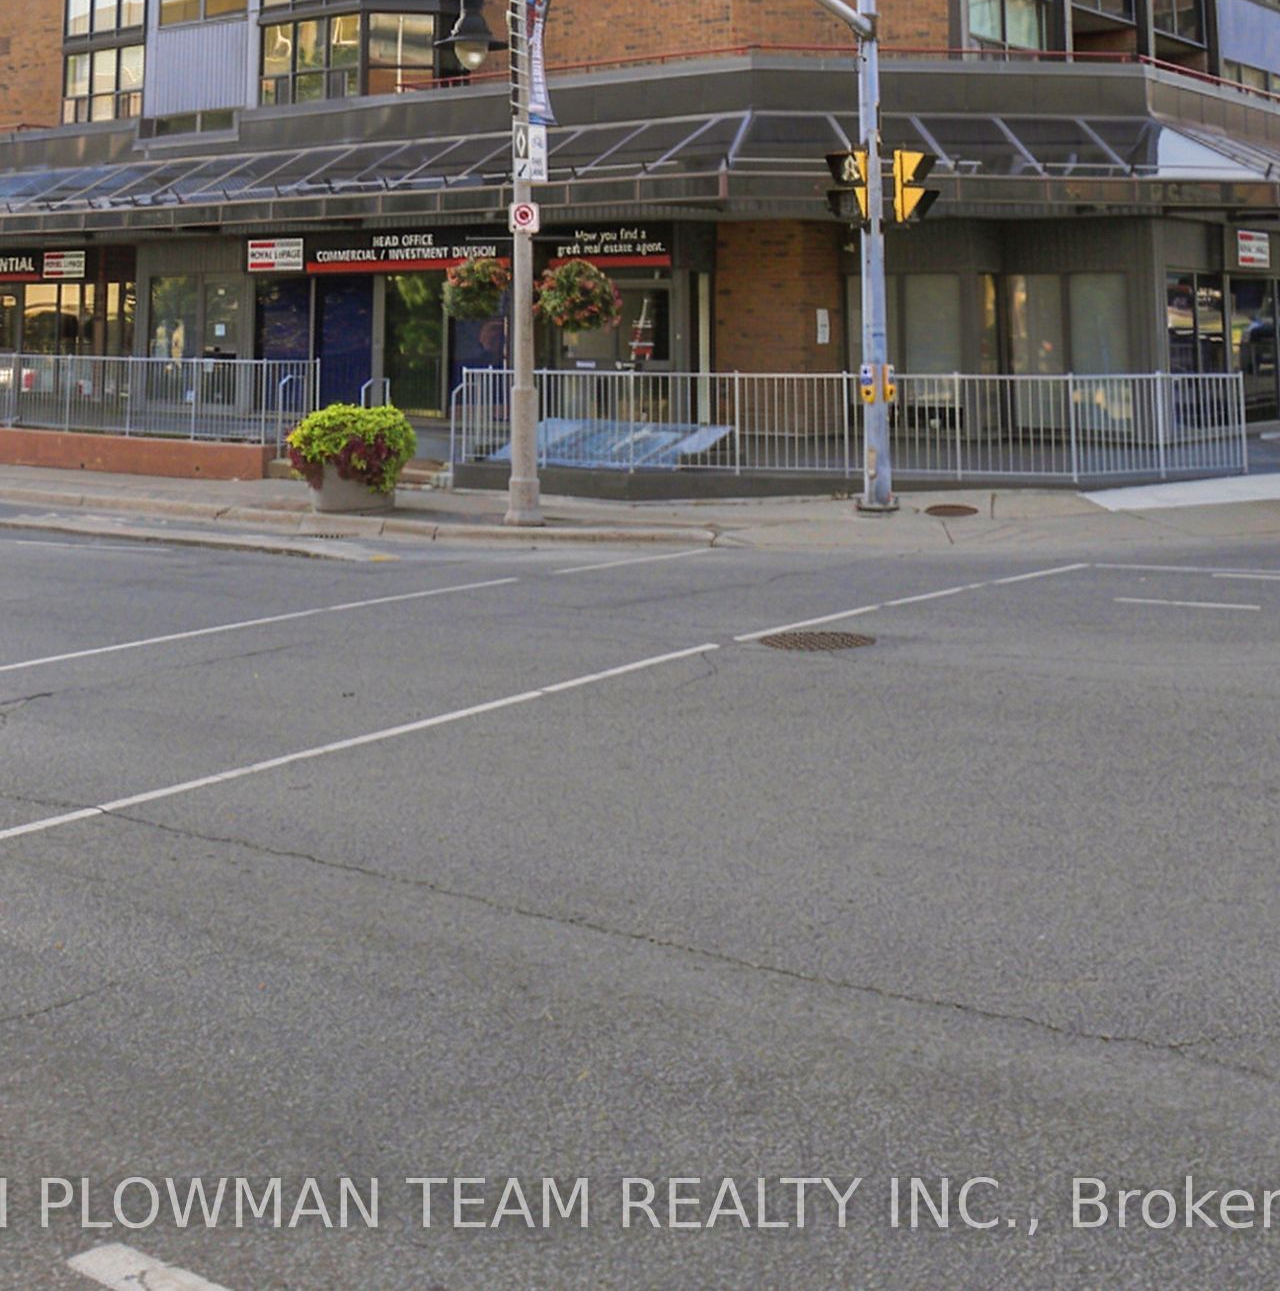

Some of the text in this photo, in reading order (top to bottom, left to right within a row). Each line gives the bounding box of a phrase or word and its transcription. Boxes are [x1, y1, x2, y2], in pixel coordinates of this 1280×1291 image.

[372, 233, 434, 247] HEAD OFFICE
[600, 231, 618, 245] you
[620, 228, 638, 240] find
[640, 230, 647, 239] a
[316, 249, 377, 263] COMMERCIAL
[388, 246, 449, 260] INVESTMENT
[452, 245, 497, 258] DIVISION
[557, 242, 581, 258] great
[583, 243, 602, 254] real
[603, 242, 633, 253] estate
